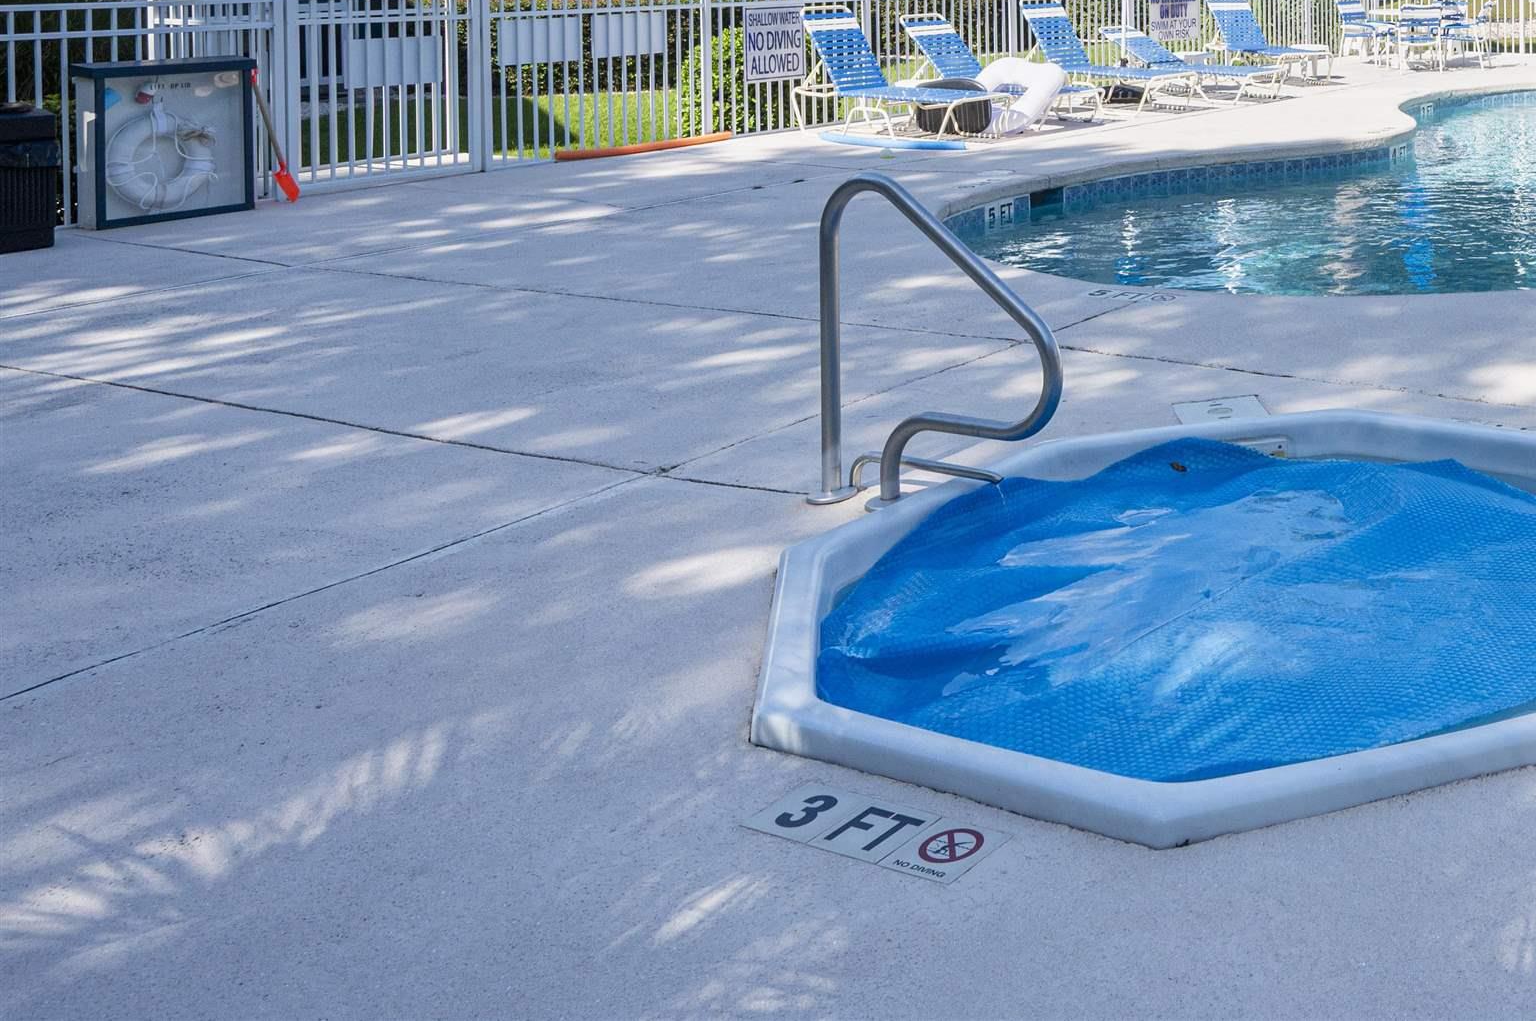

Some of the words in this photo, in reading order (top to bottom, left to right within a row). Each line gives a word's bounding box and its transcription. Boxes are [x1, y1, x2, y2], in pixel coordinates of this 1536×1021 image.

[748, 12, 778, 26] SHALLOW
[779, 11, 801, 25] WATER
[1160, 4, 1169, 19] ON
[1170, 3, 1187, 18] DUTY
[1151, 20, 1169, 31] SWIM
[1170, 19, 1178, 28] AT
[1179, 18, 1196, 28] YOUR
[748, 30, 765, 51] NO
[766, 29, 801, 51] DIVING
[1159, 30, 1174, 40] OWN
[1175, 28, 1190, 38] RISK
[751, 53, 800, 75] ALLOWED
[775, 794, 838, 828] 3
[823, 806, 926, 851] FT
[892, 859, 910, 869] NO
[910, 864, 946, 878] DIVING
